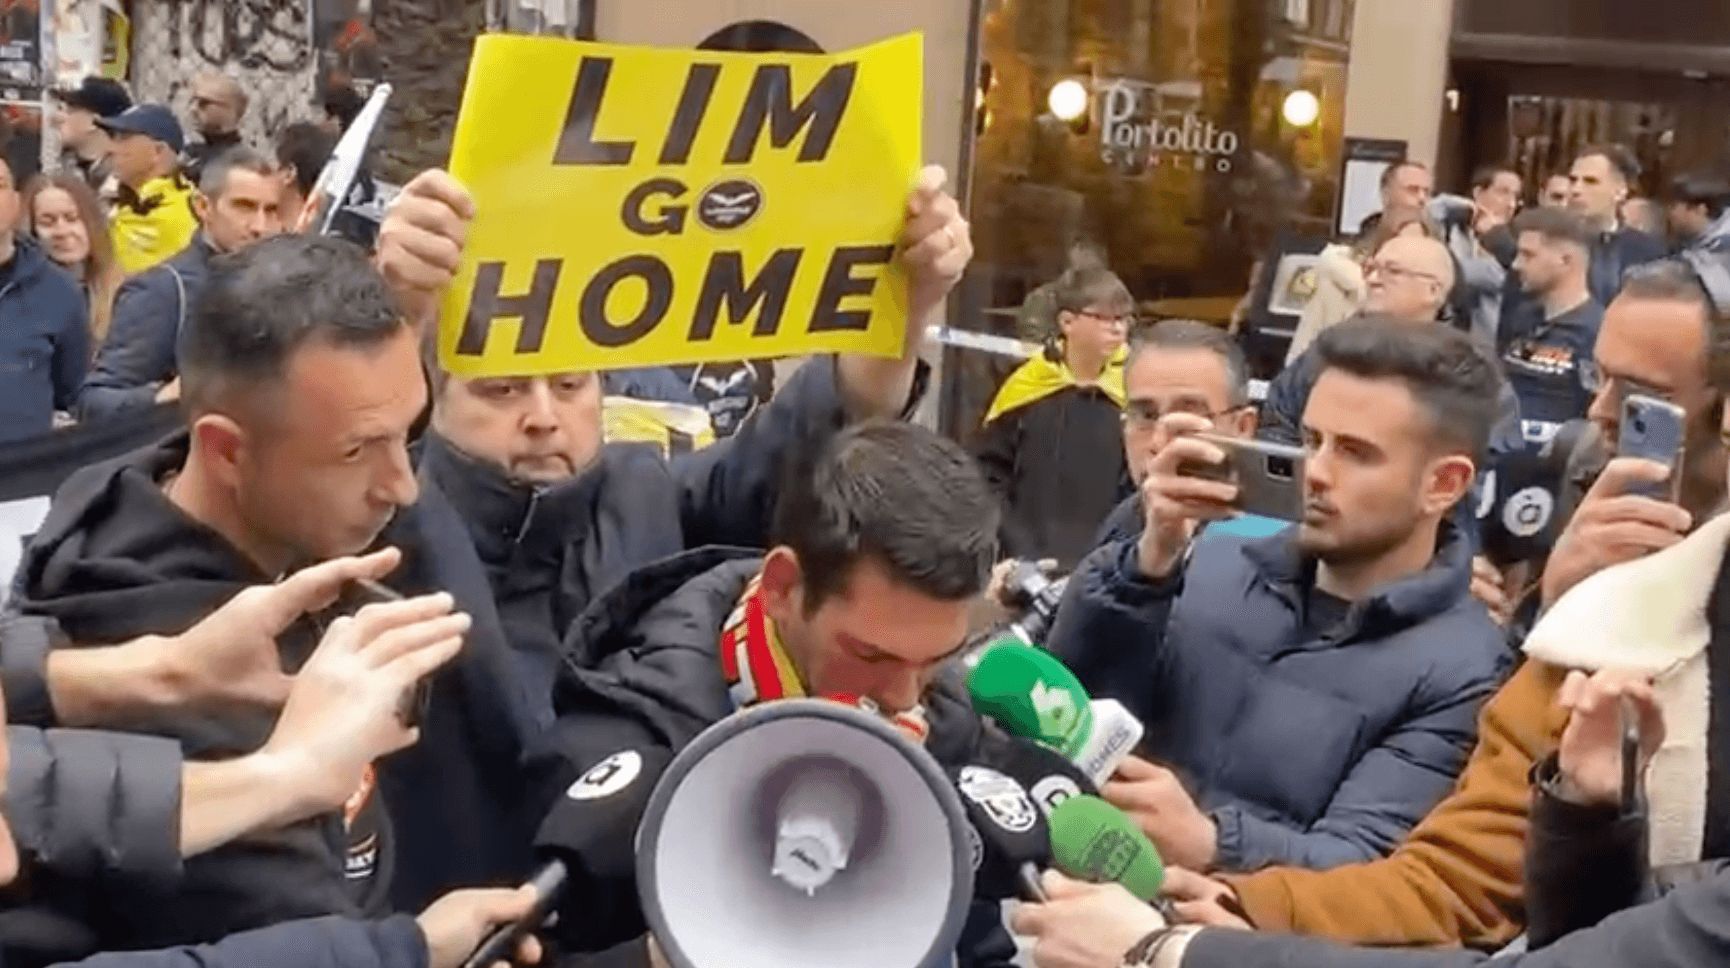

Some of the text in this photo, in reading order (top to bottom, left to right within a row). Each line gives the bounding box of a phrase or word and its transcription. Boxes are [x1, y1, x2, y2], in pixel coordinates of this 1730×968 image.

[553, 57, 858, 165] LIM
[1103, 80, 1238, 155] Portolito
[456, 244, 896, 355] HOME
